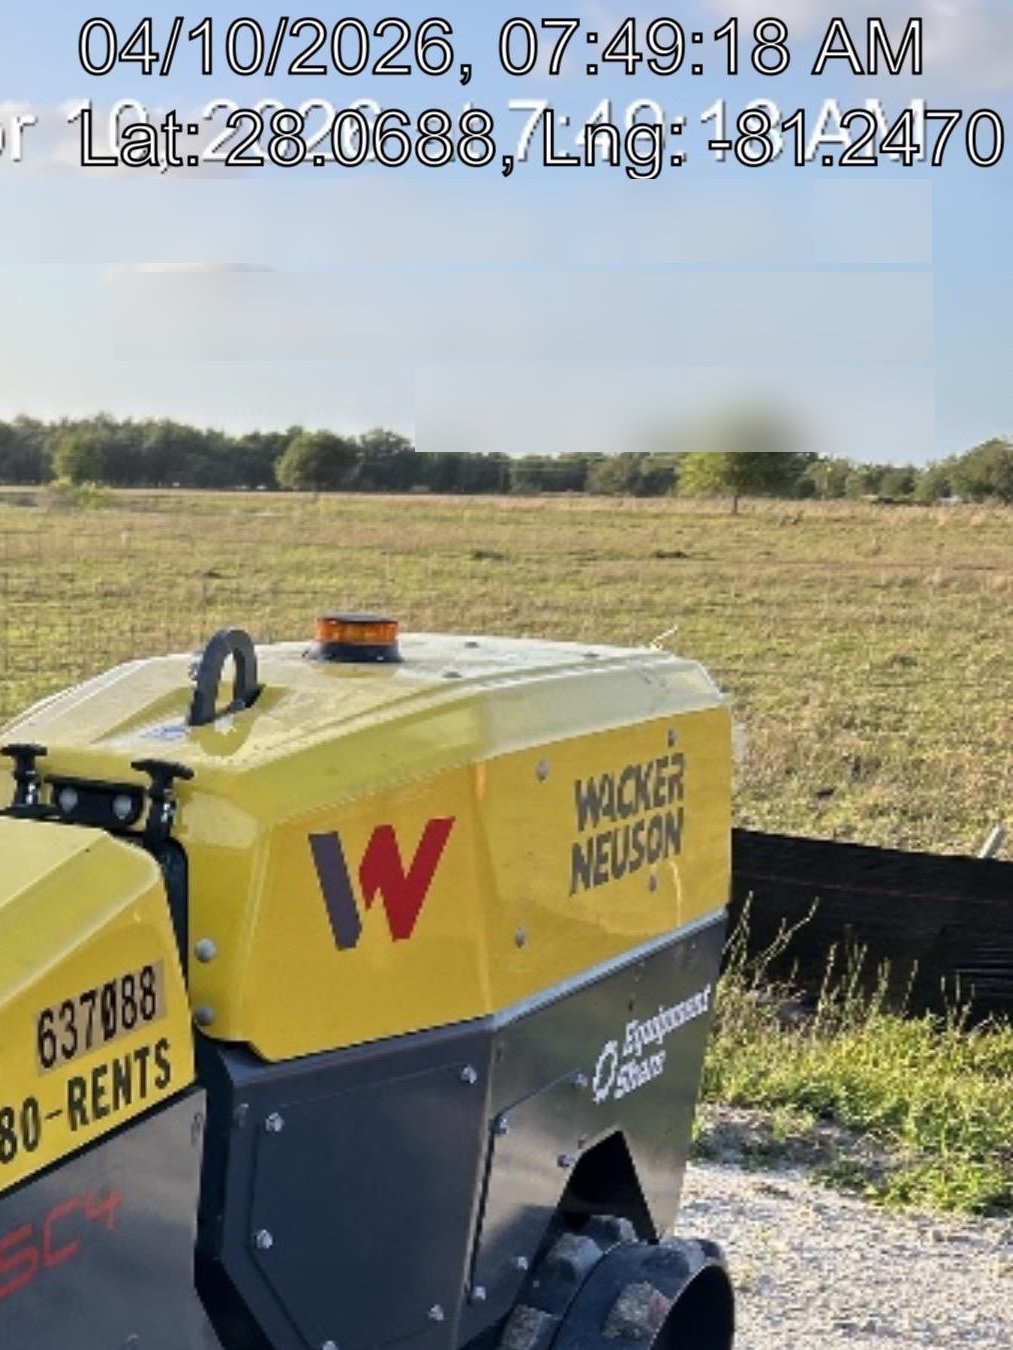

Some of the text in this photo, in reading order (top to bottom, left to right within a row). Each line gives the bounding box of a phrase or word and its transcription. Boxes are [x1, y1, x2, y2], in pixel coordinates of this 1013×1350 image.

[574, 752, 686, 833] WACKER
[569, 806, 685, 897] NEUSON
[37, 964, 158, 1069] 637088
